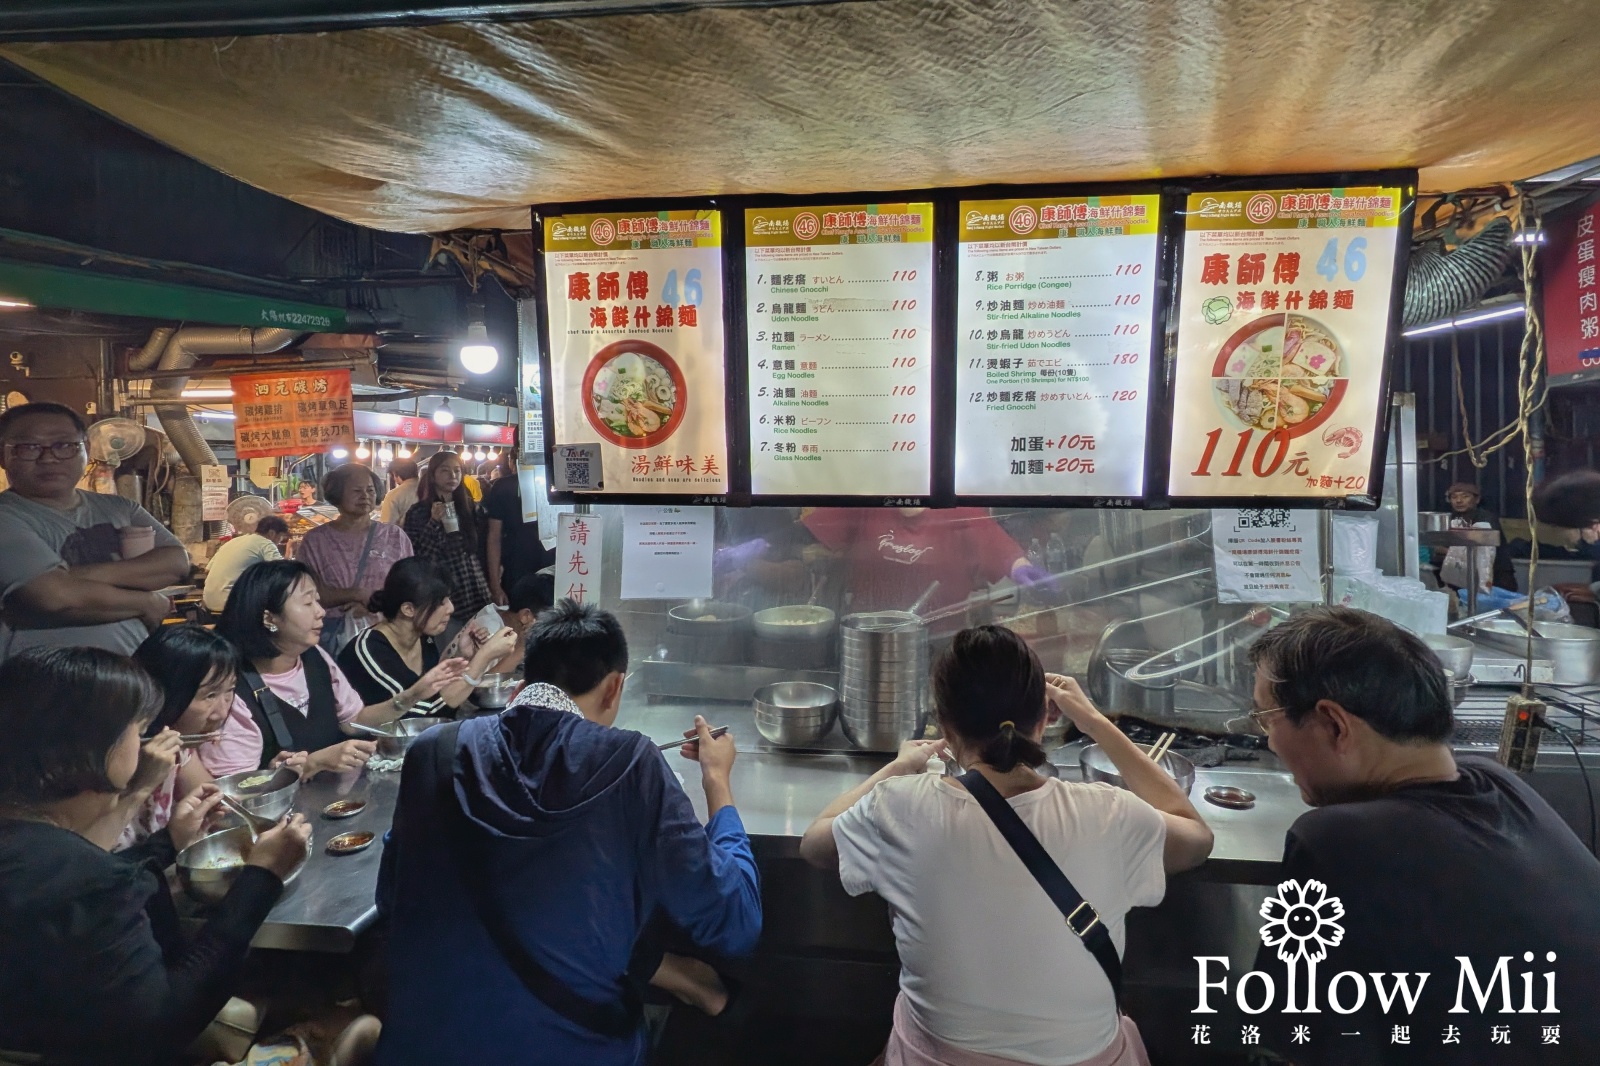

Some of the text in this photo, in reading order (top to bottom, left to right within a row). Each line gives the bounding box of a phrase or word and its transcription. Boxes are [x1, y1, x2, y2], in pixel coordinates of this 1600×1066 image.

[1253, 201, 1272, 216] 46
[798, 219, 815, 233] 46
[1015, 213, 1032, 227] 46
[594, 224, 611, 237] 46
[1316, 236, 1368, 282] 46
[975, 264, 1142, 282] 8. 粥 お粥 110
[1201, 252, 1300, 286] 康師傅
[1577, 214, 1599, 339] 皮蛋瘦肉粥
[568, 270, 648, 300] 康師傅
[757, 270, 916, 286] 1. 麵疙瘩 すいとん 110
[662, 268, 703, 309] 46
[770, 286, 798, 294] Chinese
[1038, 282, 1072, 290] (Congee)
[756, 300, 916, 314] 2. 烏龍麵 うどん 110
[975, 300, 984, 311] 9.
[987, 300, 1024, 312] 炒油麵
[1114, 294, 1140, 306] 110
[1236, 290, 1354, 311] 海鮮什錦麵
[590, 305, 697, 328] 海鮮什錦麵
[756, 329, 916, 342] 3. 拉麵 ラーメン 110
[969, 324, 1140, 340] 10. 炒烏龍 炒めうどん 110
[758, 360, 768, 370] 4.
[772, 360, 796, 370] 意麵
[892, 357, 916, 368] 110
[969, 358, 984, 368] 11.
[1028, 358, 1062, 368] 茹でエビ
[1113, 354, 1138, 364] 180
[772, 372, 786, 380] Egg
[987, 370, 1010, 378] Boiled
[1011, 370, 1036, 378] Shrimp
[254, 378, 328, 396] 泗元碳烤
[758, 387, 769, 397] 5.
[773, 388, 796, 398] 油麵
[892, 386, 916, 396] 110
[969, 390, 1138, 403] 12. 炒麵疙瘩 炒めすいとん 120
[760, 414, 916, 426] 6. 米粉 ビーフン 110
[760, 442, 916, 454] 7. 冬粉 春雨 110
[1011, 434, 1096, 452] 加蛋+10元
[1191, 428, 1310, 478] 110元
[631, 454, 720, 476] 湯鮮味美
[1011, 458, 1094, 474] 加麵+20元
[1306, 475, 1365, 490] 加麵+20
